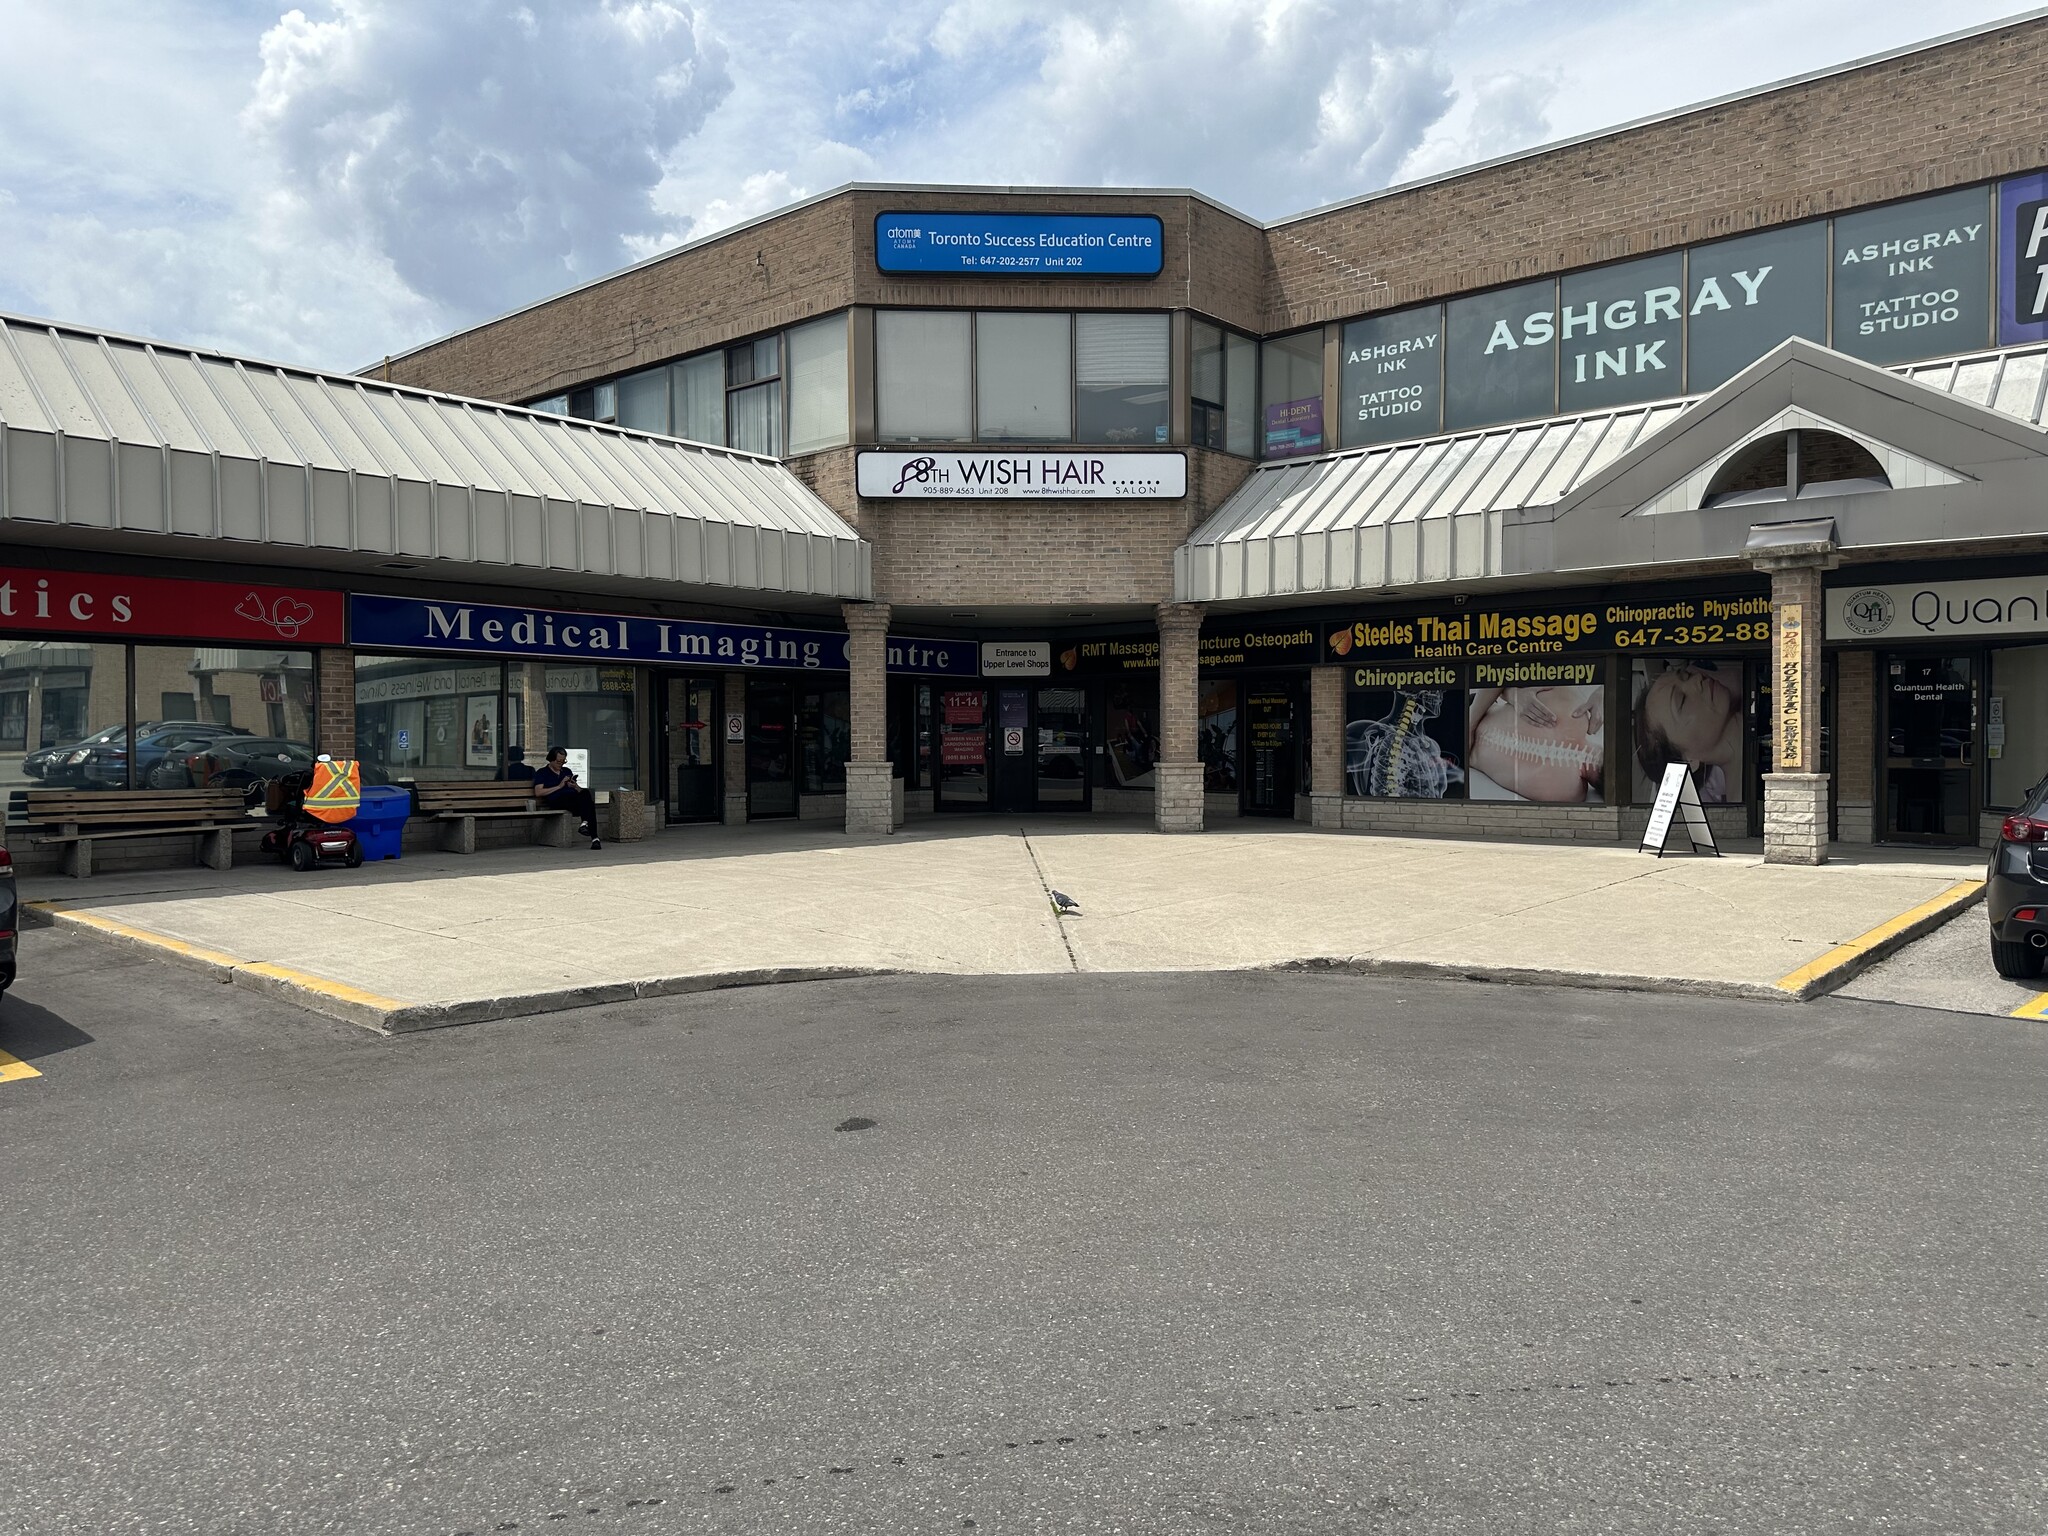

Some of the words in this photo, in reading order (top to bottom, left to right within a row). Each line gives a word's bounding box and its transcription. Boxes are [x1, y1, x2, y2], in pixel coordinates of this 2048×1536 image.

[928, 231, 981, 246] Toronto
[984, 232, 1036, 247] Success
[1039, 233, 1104, 247] Education
[1108, 233, 1152, 247] Centre
[1842, 223, 1982, 266] ASHGRAY
[961, 255, 978, 265] Tel:
[980, 256, 1040, 266] 647-202-2577
[1045, 257, 1064, 266] Unit
[1066, 257, 1083, 266] 202
[1888, 255, 1934, 276] INK
[1484, 265, 1773, 355] ASHGRAY
[1860, 288, 1959, 317] TATTOO
[1859, 307, 1959, 335] STUDIO
[1347, 333, 1438, 365] ASHGRAY
[1376, 358, 1407, 375] INK
[1574, 339, 1667, 383] INK
[1359, 384, 1423, 406] TATTOO
[1279, 404, 1312, 418] HI-DENT
[1358, 400, 1423, 421] STUDIO
[956, 459, 1032, 485] WISH
[1042, 459, 1106, 485] HAIR
[978, 486, 993, 495] Unit
[994, 487, 1009, 495] 208
[1022, 486, 1096, 495] www.8thwishhair.com
[1115, 486, 1157, 495] SALON
[0, 579, 133, 623] tics
[1846, 590, 1872, 608] QUANTUM
[1872, 591, 1892, 606] HEALTH
[1606, 602, 1695, 624] Chiropractic
[1911, 589, 2048, 632] Quan
[424, 605, 630, 650] Medical
[657, 624, 821, 668] Imaging
[1354, 619, 1413, 647] Steeles
[1417, 613, 1471, 642] Thai
[1479, 612, 1598, 642] Massage
[995, 648, 1028, 657] Entrance
[1029, 649, 1037, 657] to
[1081, 642, 1107, 657] RMT
[1109, 641, 1160, 657] Massage
[1244, 629, 1313, 649] Osteopath
[1414, 642, 1462, 658] Health
[1465, 640, 1503, 656] Care
[1506, 638, 1563, 654] Centre
[983, 659, 1005, 670] Upper
[1007, 659, 1026, 668] Level
[1027, 659, 1050, 669] Shops
[1476, 663, 1596, 687] Physiotherapy
[1921, 668, 1932, 676] 17
[1354, 666, 1456, 689] Chiropractic
[1781, 661, 1799, 715] HOLISTIC
[1893, 683, 1934, 692] Quantum
[1935, 683, 1965, 691] Health
[949, 696, 979, 707] 11-14
[1914, 693, 1943, 701] Dental
[1782, 717, 1799, 760] CENTRE
